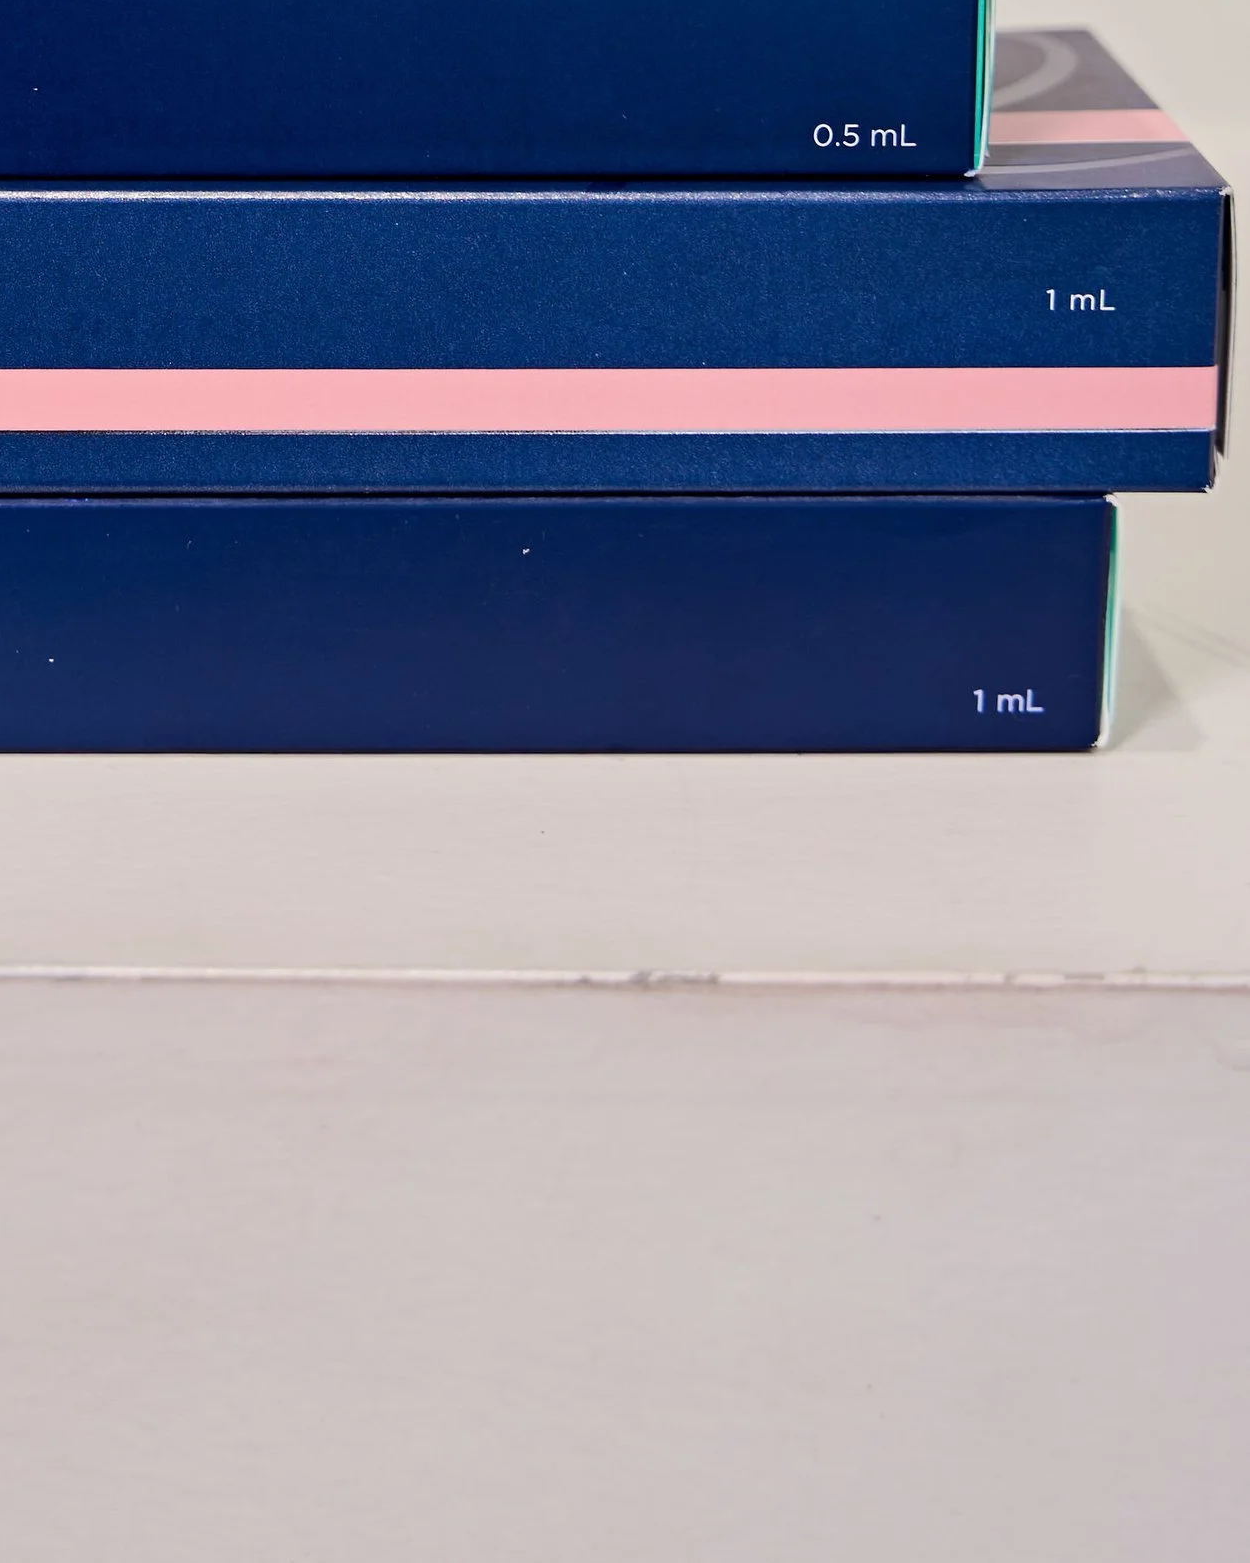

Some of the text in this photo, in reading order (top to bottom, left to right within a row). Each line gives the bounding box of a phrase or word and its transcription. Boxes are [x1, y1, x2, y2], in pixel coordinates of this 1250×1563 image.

[813, 123, 917, 148] 0.5 mL
[1046, 288, 1116, 311] 1 mL
[973, 688, 1044, 713] 1 mL
